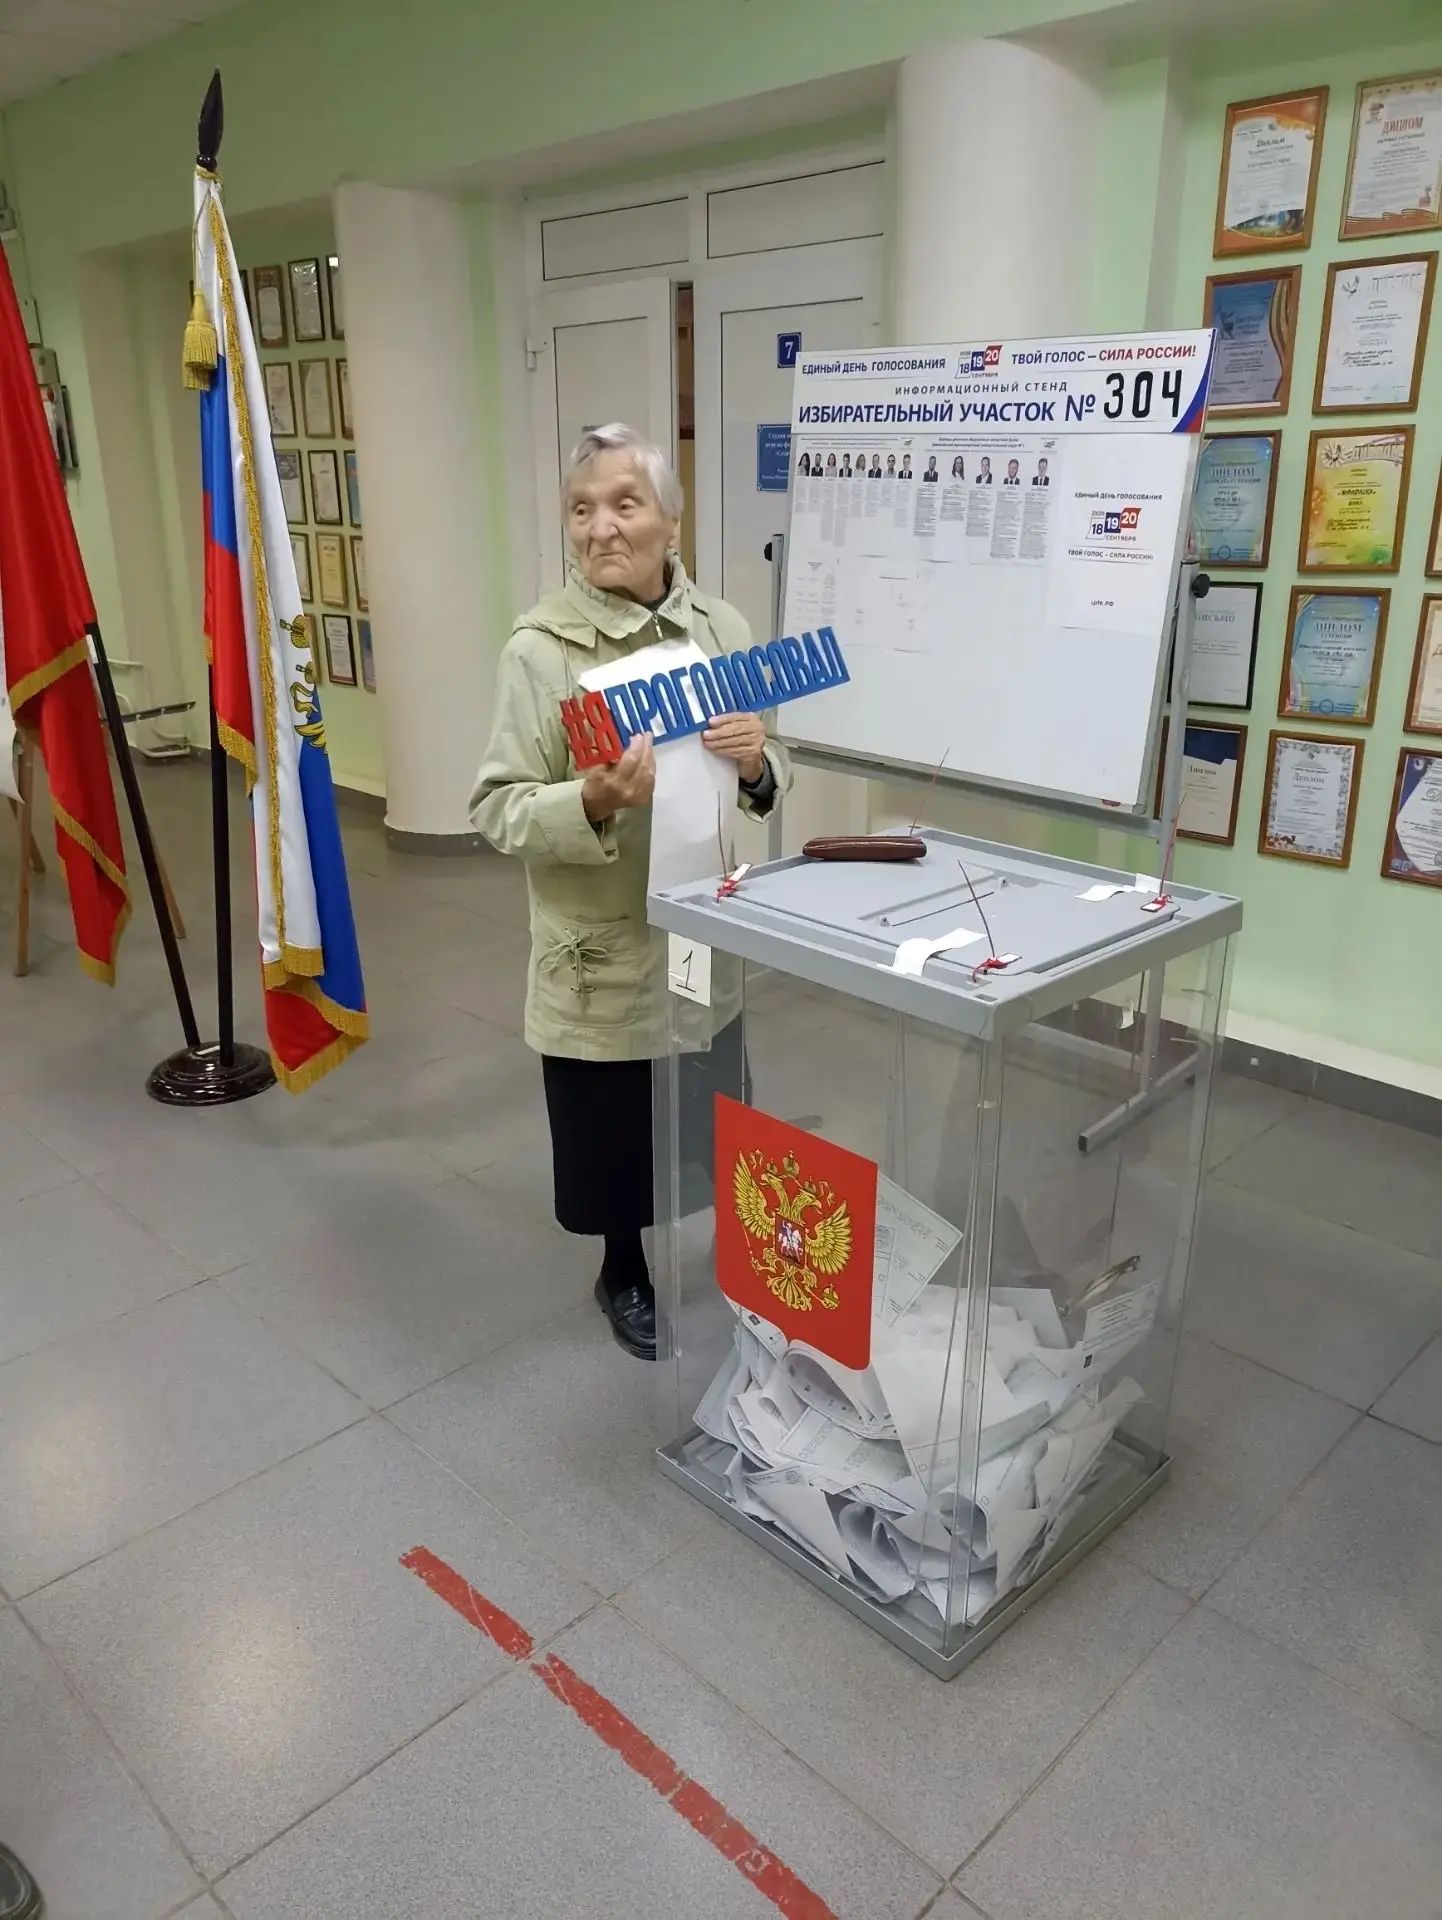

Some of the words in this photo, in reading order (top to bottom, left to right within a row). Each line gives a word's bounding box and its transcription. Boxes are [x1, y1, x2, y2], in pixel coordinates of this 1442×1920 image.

[784, 341, 794, 360] 7
[1011, 350, 1042, 365] ТВОЙ
[1045, 350, 1086, 363] ГОЛОС
[1099, 349, 1133, 361] СИЛА
[1136, 345, 1197, 359] РОССИИ!
[802, 361, 841, 375] ЕДИНЫЙ
[842, 363, 868, 375] ДЕНЬ
[871, 358, 946, 372] ГОЛОСОВАНИЯ
[959, 362, 971, 374] 18
[971, 354, 983, 368] 19
[985, 349, 999, 362] 20
[799, 399, 953, 423] ИЗБИРАТЕЛЬНЫЙ
[959, 401, 1056, 422] УЧАСТОК
[1064, 393, 1097, 422] №
[1103, 369, 1182, 419] 304
[895, 381, 1019, 396] ИНФОРМАЦИОННЫЙ
[1025, 381, 1068, 393] СТЕНД
[1074, 491, 1099, 499] ЕДИНЫЙ
[1116, 493, 1163, 501] ГОЛОСОВАНИЯ
[1091, 523, 1103, 535] 18
[1106, 517, 1119, 529] 19
[1121, 512, 1138, 525] 20
[1068, 548, 1083, 556] ТВОЙ
[1084, 550, 1104, 558] ГОЛОС
[676, 949, 697, 993] 1
